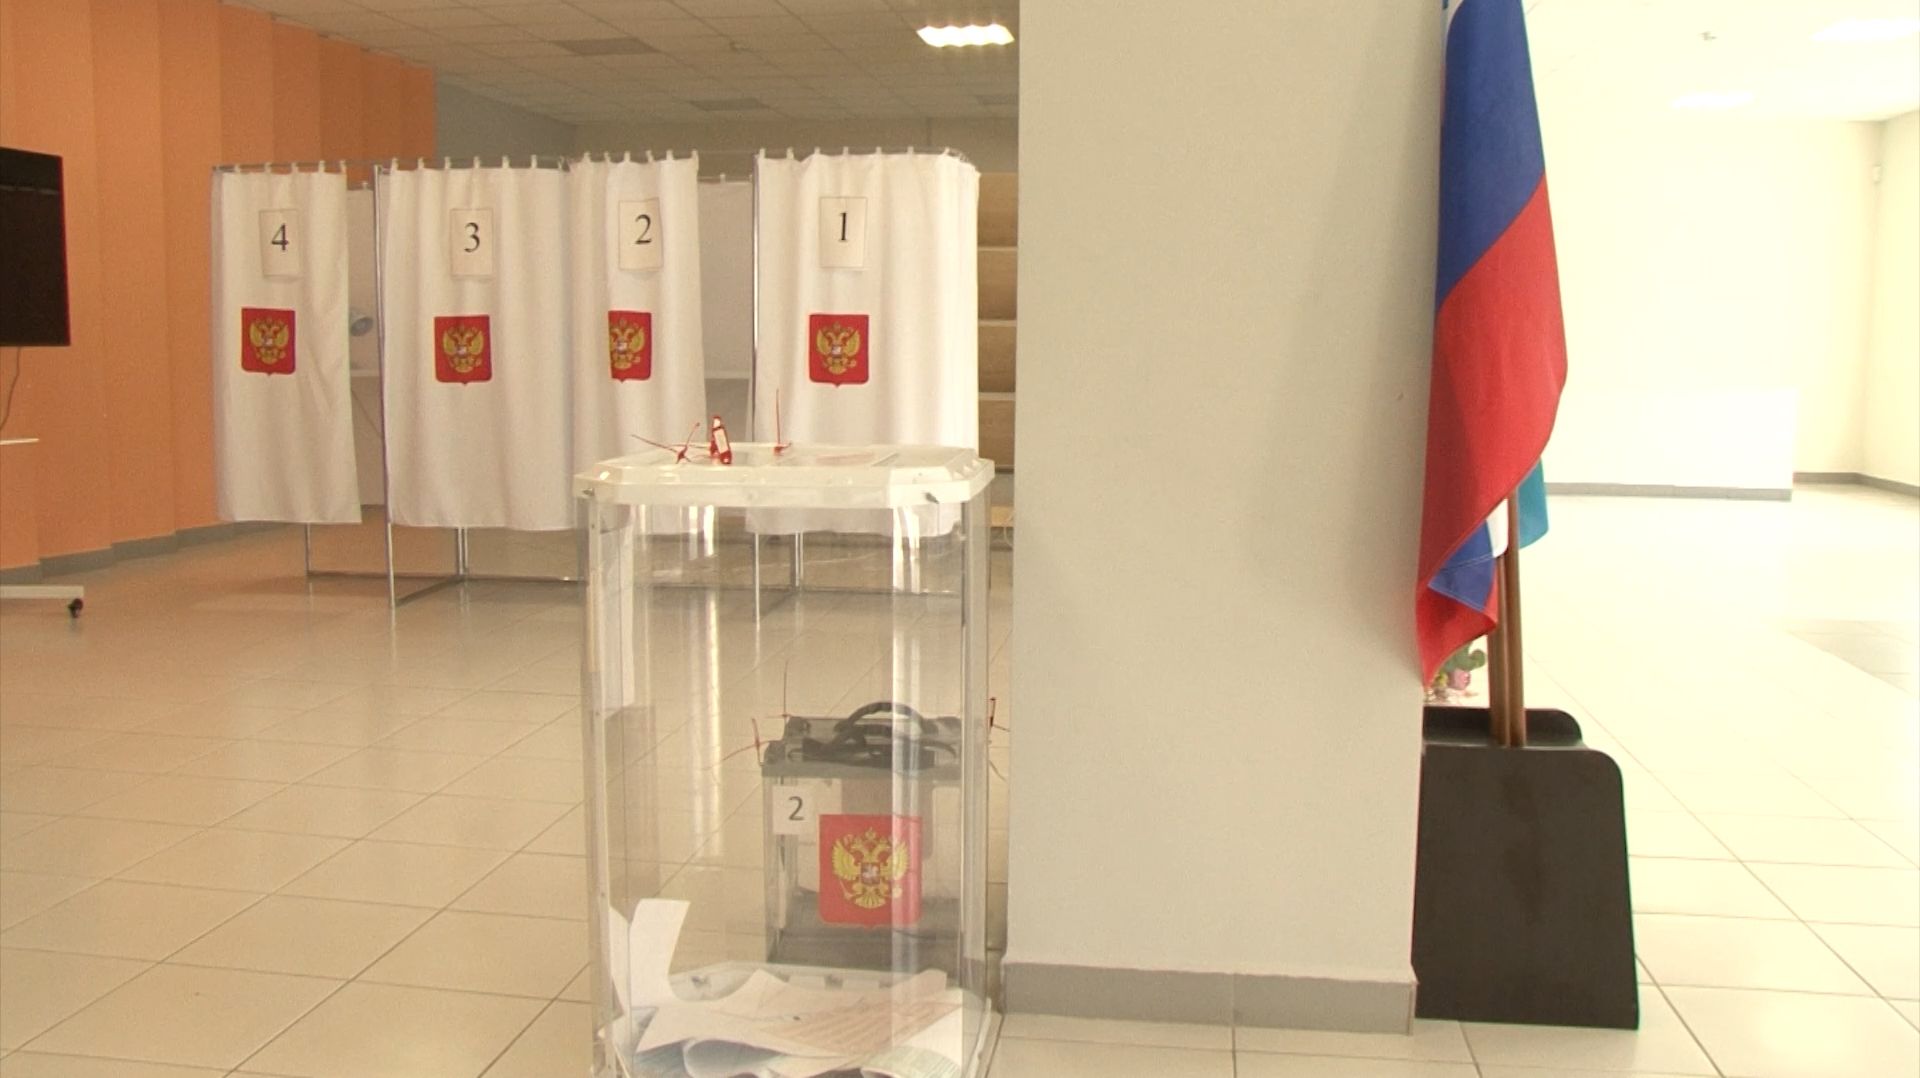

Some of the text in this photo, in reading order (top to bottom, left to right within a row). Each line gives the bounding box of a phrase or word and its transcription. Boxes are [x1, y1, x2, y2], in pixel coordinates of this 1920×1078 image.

[271, 223, 290, 252] 4
[463, 222, 481, 253] 3
[634, 214, 653, 245] 2
[837, 212, 850, 241] 1
[788, 796, 804, 821] 2
